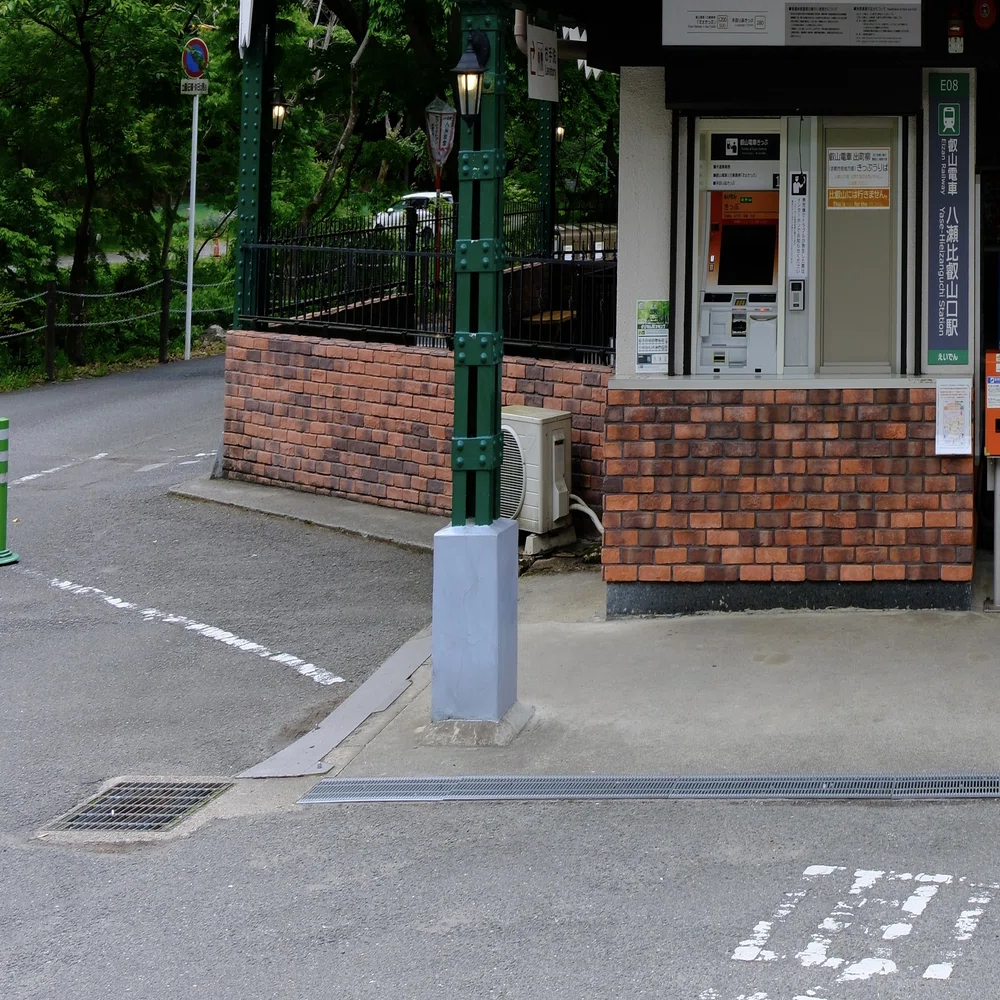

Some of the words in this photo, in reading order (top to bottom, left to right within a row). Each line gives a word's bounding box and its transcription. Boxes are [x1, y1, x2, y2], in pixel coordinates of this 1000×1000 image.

[940, 79, 958, 91] E08
[829, 152, 852, 161] 叡山電車
[853, 152, 870, 161] 出町柳
[948, 138, 958, 196] 叡山電車
[829, 190, 888, 199] 比叡山には行きません。
[938, 207, 946, 297] Yase-Hieizanguchi
[946, 206, 958, 336] 八瀬比叡山口駅
[938, 353, 958, 361] えいでん
